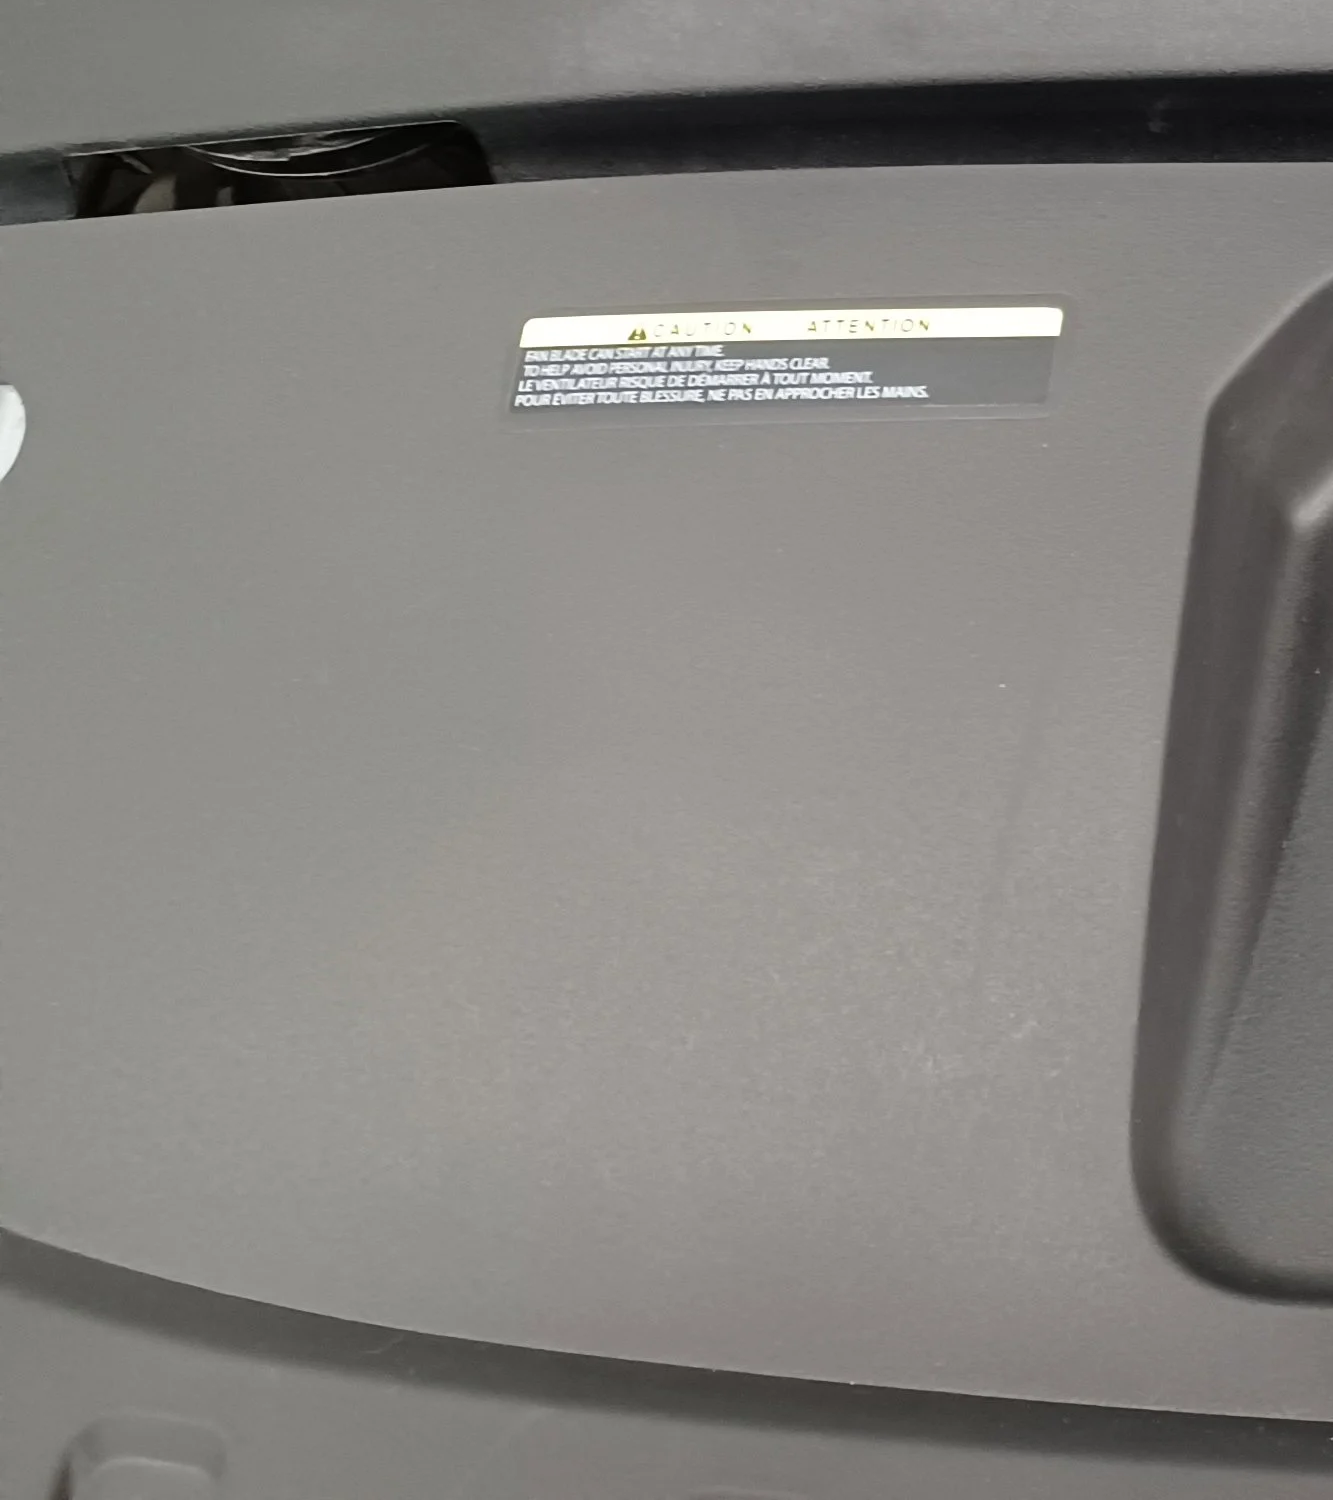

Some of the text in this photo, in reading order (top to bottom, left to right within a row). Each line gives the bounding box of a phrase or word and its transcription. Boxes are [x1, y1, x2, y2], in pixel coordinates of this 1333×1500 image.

[653, 318, 930, 338] CAUTION ATTENTION
[524, 350, 549, 363] FAN
[550, 349, 588, 362] BLADE
[588, 348, 614, 361] CAN
[614, 347, 650, 360] START
[650, 346, 666, 359] AT
[666, 346, 694, 358] ANY
[523, 364, 540, 377] TO
[541, 363, 570, 377] HELP
[570, 362, 608, 375] AVOID
[608, 360, 669, 374] PERSONAL
[714, 358, 745, 371] KEEP
[744, 357, 789, 371] HANDS
[517, 380, 534, 393] LE
[535, 376, 618, 392] VENTILATEUR
[618, 375, 666, 389] RISQUE
[667, 374, 686, 388] DE
[687, 372, 759, 387] DÉMARRER
[773, 372, 809, 385] TOUT
[513, 394, 552, 407] POUR
[595, 391, 639, 404] TOUTE
[706, 388, 727, 402] NE
[726, 388, 753, 401] PAS
[754, 387, 775, 401] EN
[774, 386, 855, 400] APPROCHER
[855, 385, 881, 399] LES
